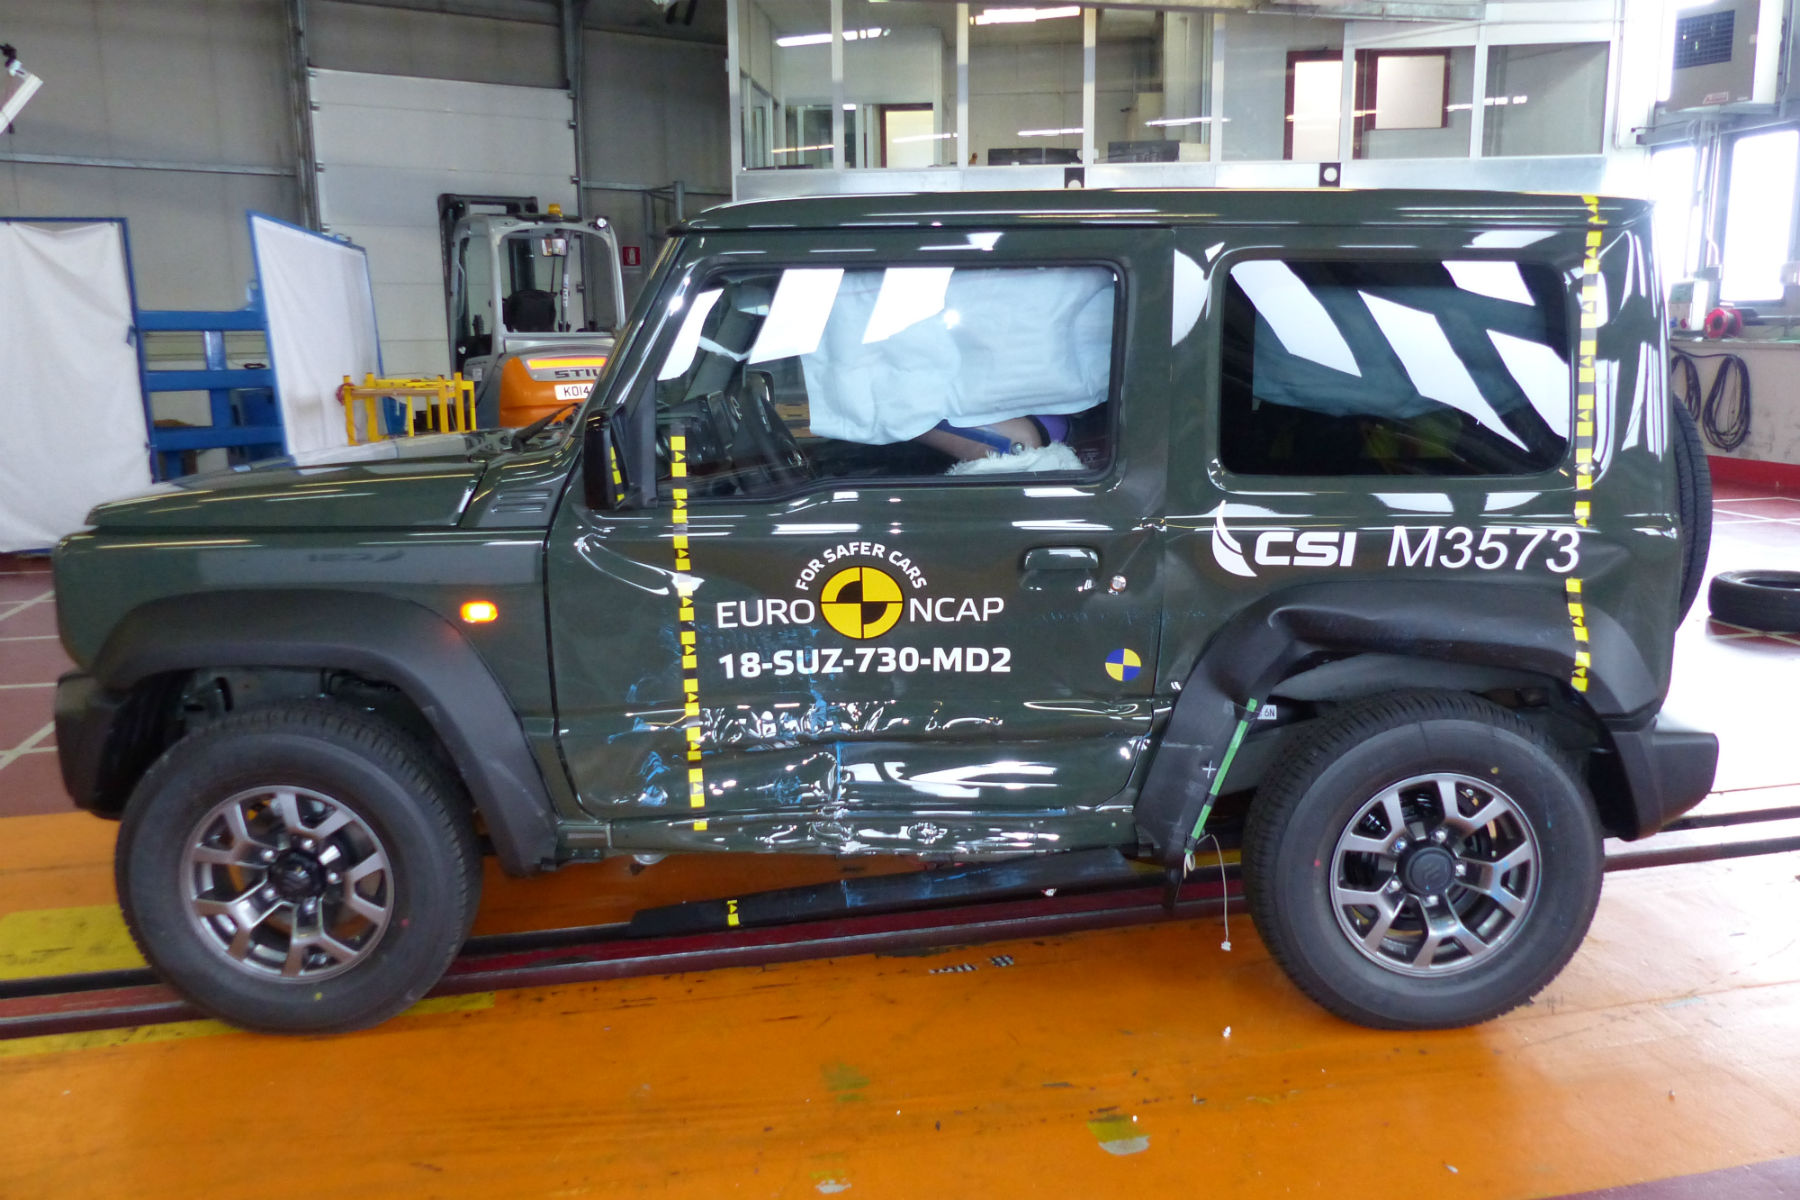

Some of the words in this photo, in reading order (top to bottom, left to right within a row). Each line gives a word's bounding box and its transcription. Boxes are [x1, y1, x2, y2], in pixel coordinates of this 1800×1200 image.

[796, 558, 825, 591] FOR
[823, 541, 885, 564] SAFER
[888, 550, 927, 590] CARS
[1254, 531, 1357, 567] CSI
[1387, 525, 1580, 573] M3573
[717, 598, 816, 628] EURO
[909, 597, 1005, 623] NCAP
[718, 647, 1012, 679] 18-SUZ-730-MD2
